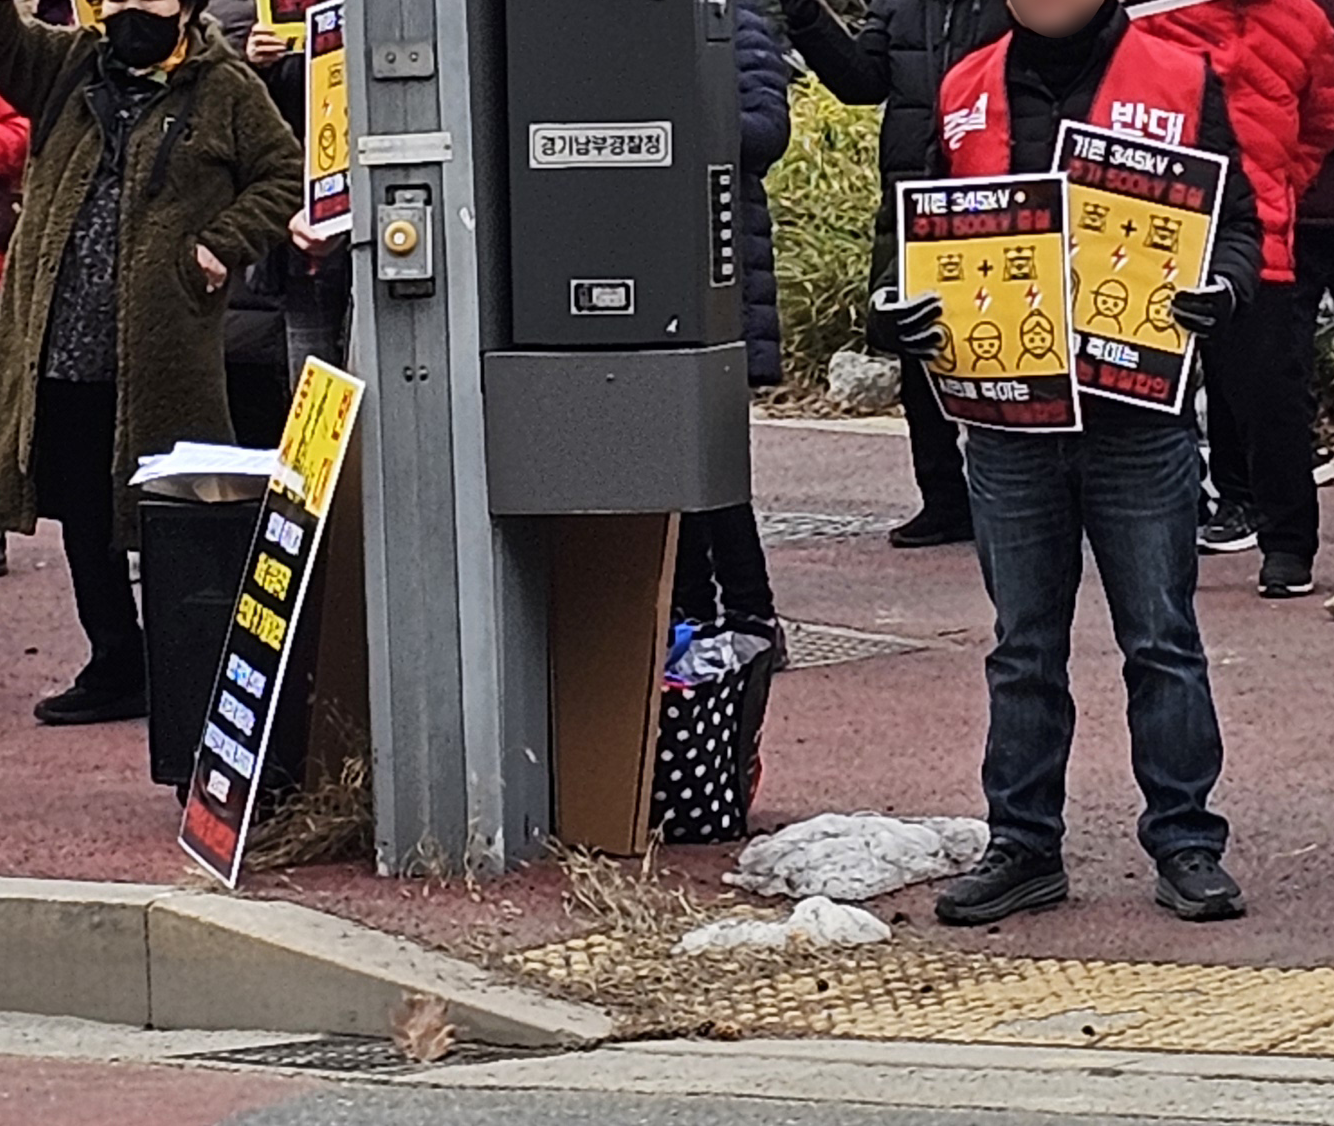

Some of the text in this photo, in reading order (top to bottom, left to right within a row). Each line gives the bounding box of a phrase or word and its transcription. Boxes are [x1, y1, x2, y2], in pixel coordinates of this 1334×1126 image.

[1110, 100, 1186, 146] 반대
[540, 134, 662, 157] 경기남부경찰청
[1071, 133, 1106, 162] 기존
[1109, 145, 1169, 176] 345kV
[911, 192, 948, 215] 기존
[951, 189, 1011, 213] 345kV
